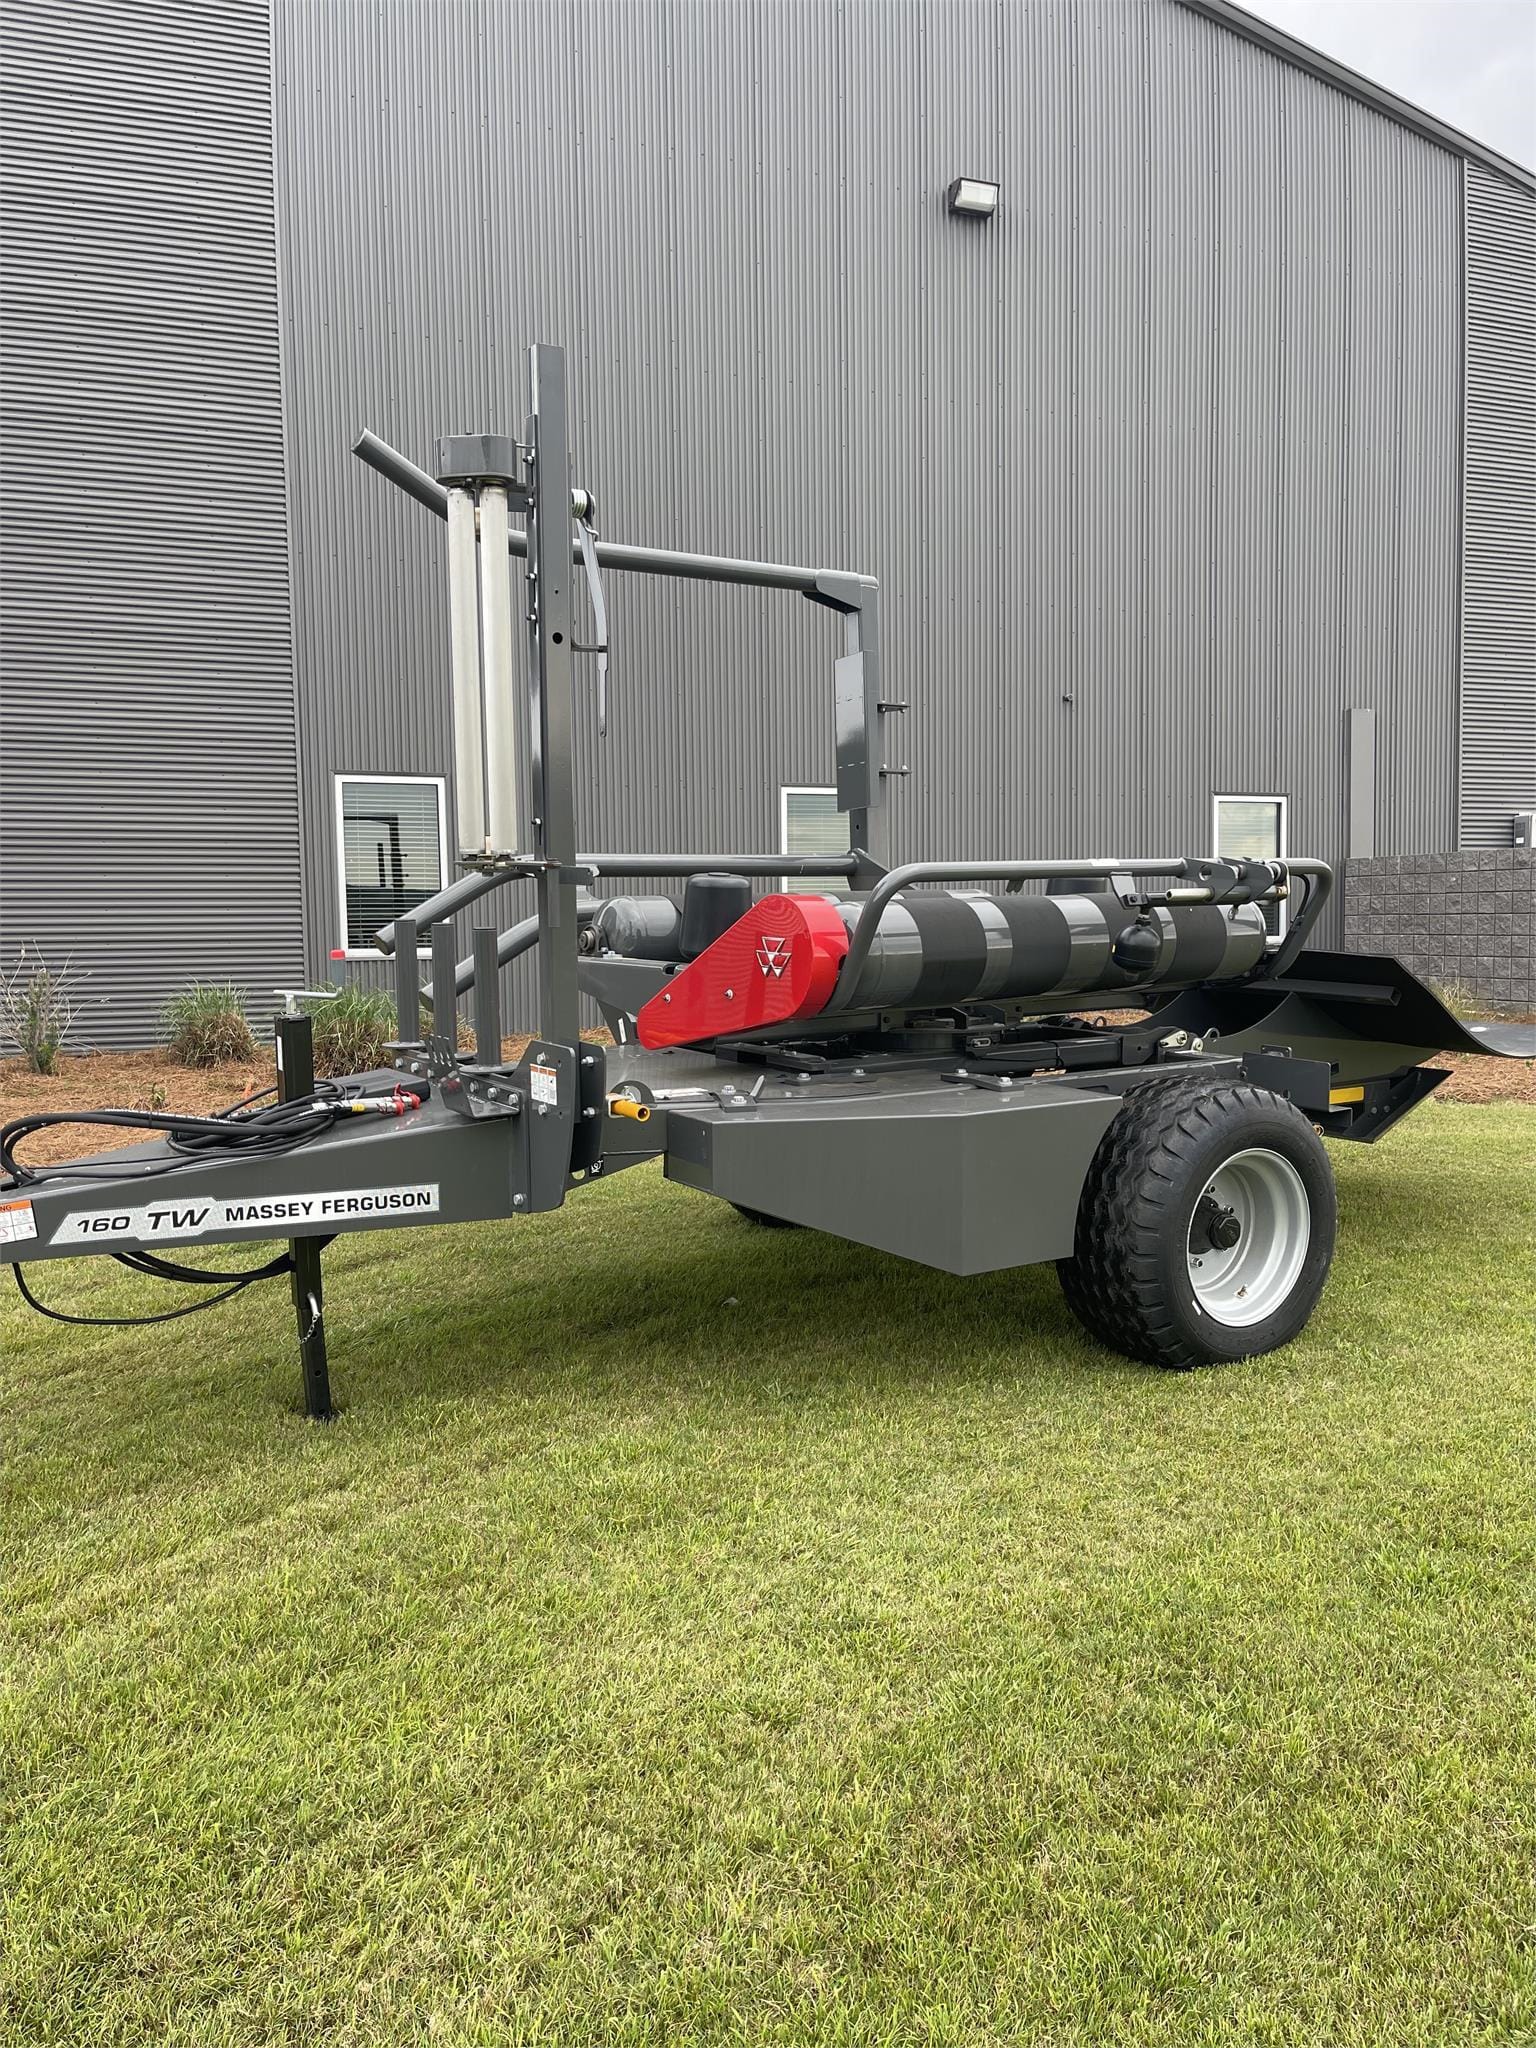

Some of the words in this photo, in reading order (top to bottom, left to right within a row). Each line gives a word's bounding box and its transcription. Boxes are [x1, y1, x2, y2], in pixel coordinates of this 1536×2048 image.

[77, 1215, 131, 1233] 160
[147, 1207, 210, 1230] TW
[225, 1201, 314, 1222] MASSEY
[322, 1191, 431, 1214] FERGUSON
